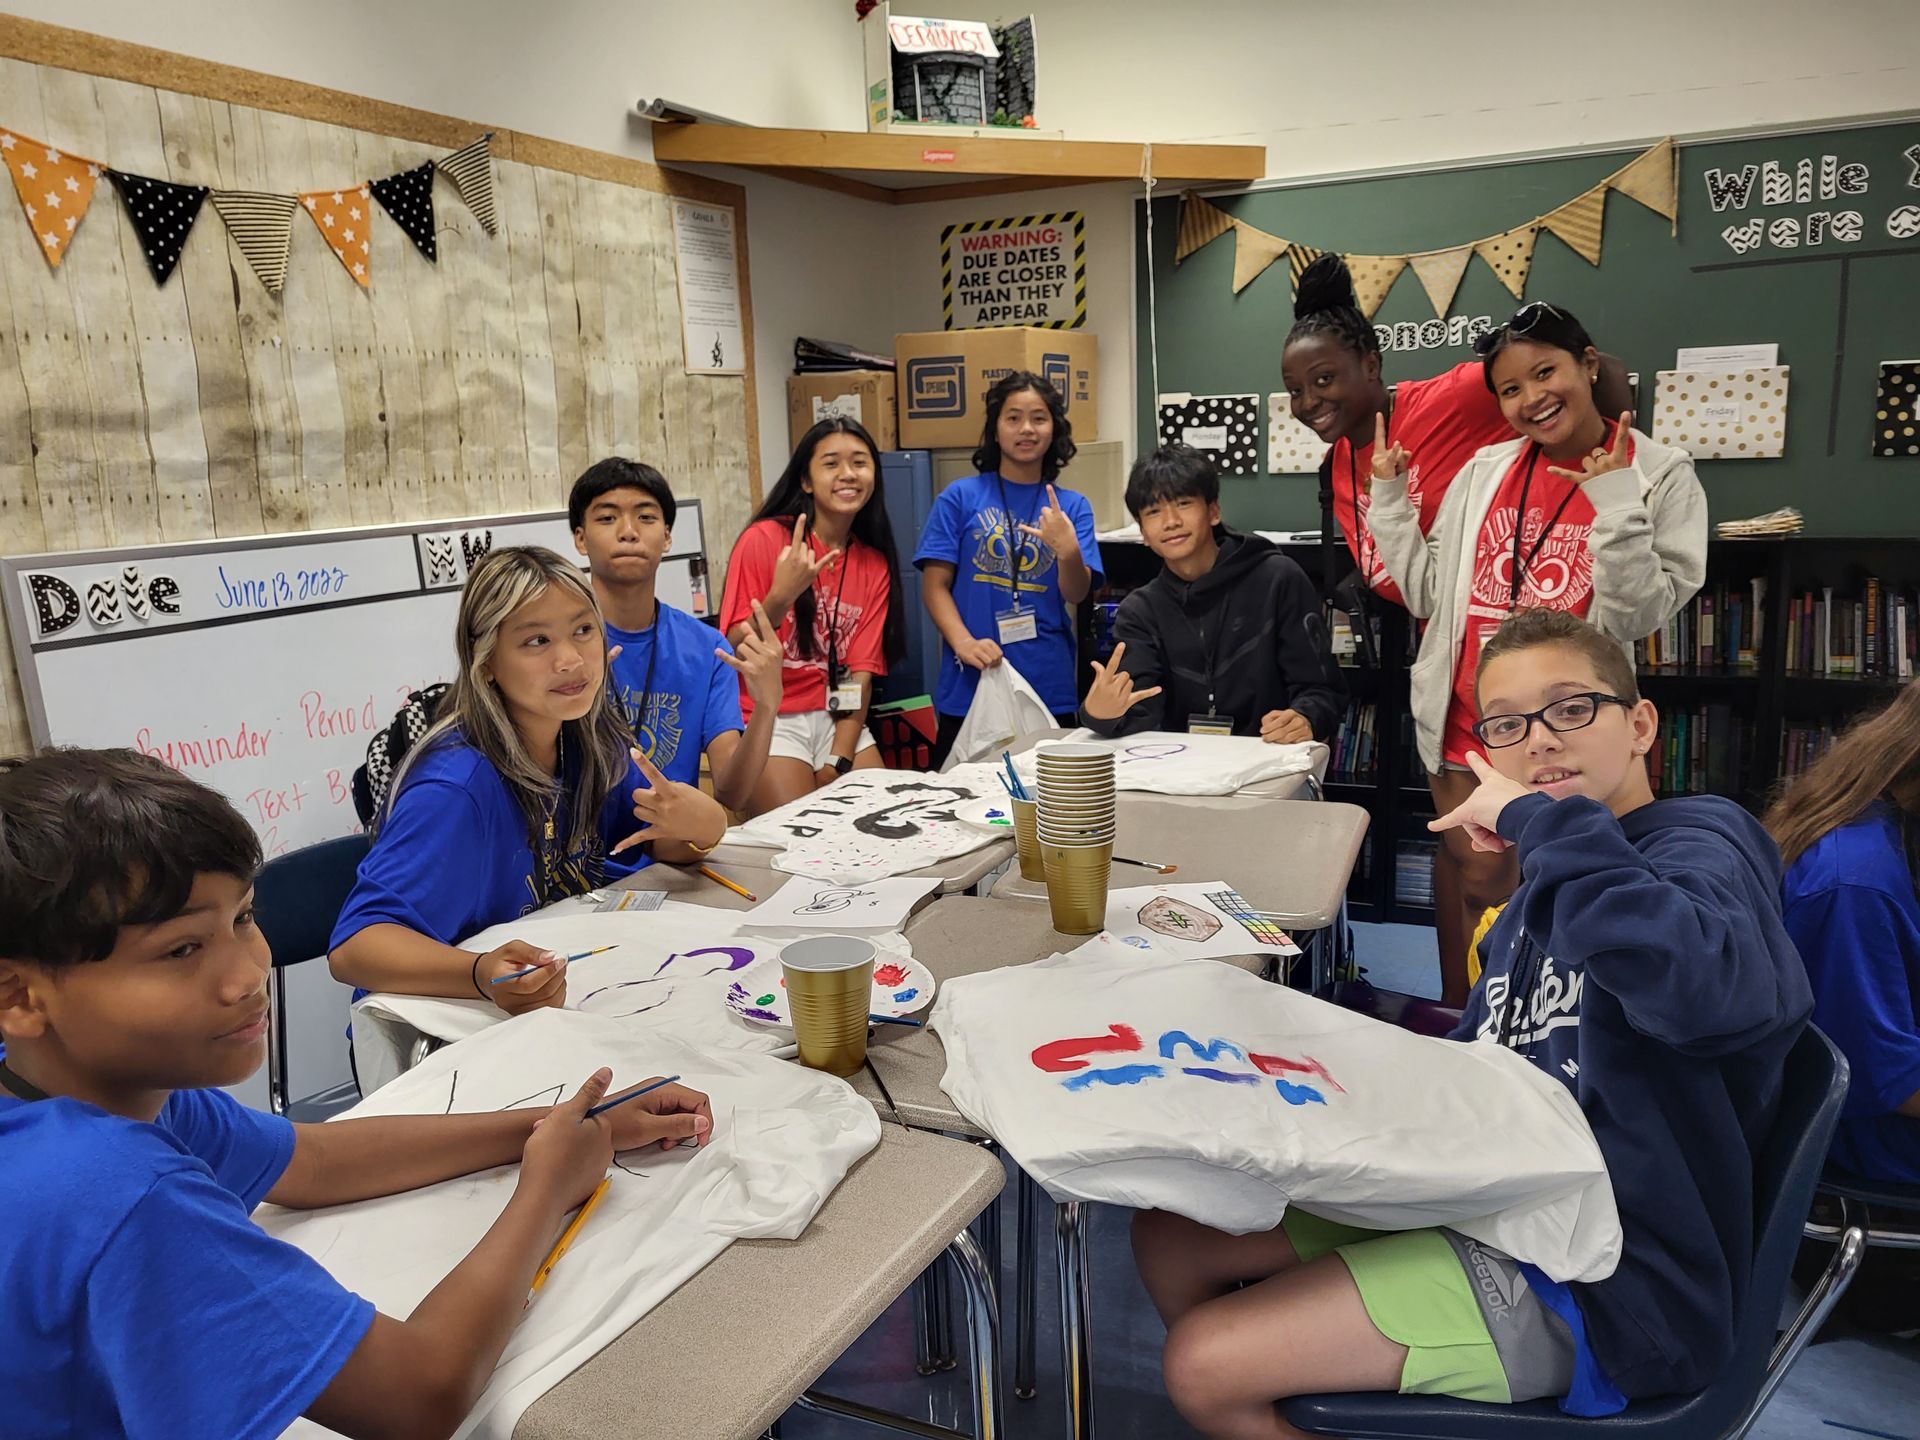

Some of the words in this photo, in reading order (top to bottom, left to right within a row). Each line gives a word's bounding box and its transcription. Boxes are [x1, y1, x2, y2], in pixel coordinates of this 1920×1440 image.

[1704, 155, 1869, 212] While
[961, 228, 1063, 253] WARNING:
[1721, 210, 1864, 254] were
[958, 271, 991, 289] ARE
[997, 265, 1067, 285] CLOSER
[963, 252, 998, 270] DUE
[1004, 247, 1060, 266] DATES
[960, 287, 1011, 306] THAN
[1018, 283, 1064, 301] THEY
[977, 303, 1049, 322] APPEAR
[425, 529, 492, 584] HW
[26, 566, 182, 636] Date
[215, 565, 268, 609] June
[297, 566, 349, 601] 2022
[299, 690, 378, 740] Period
